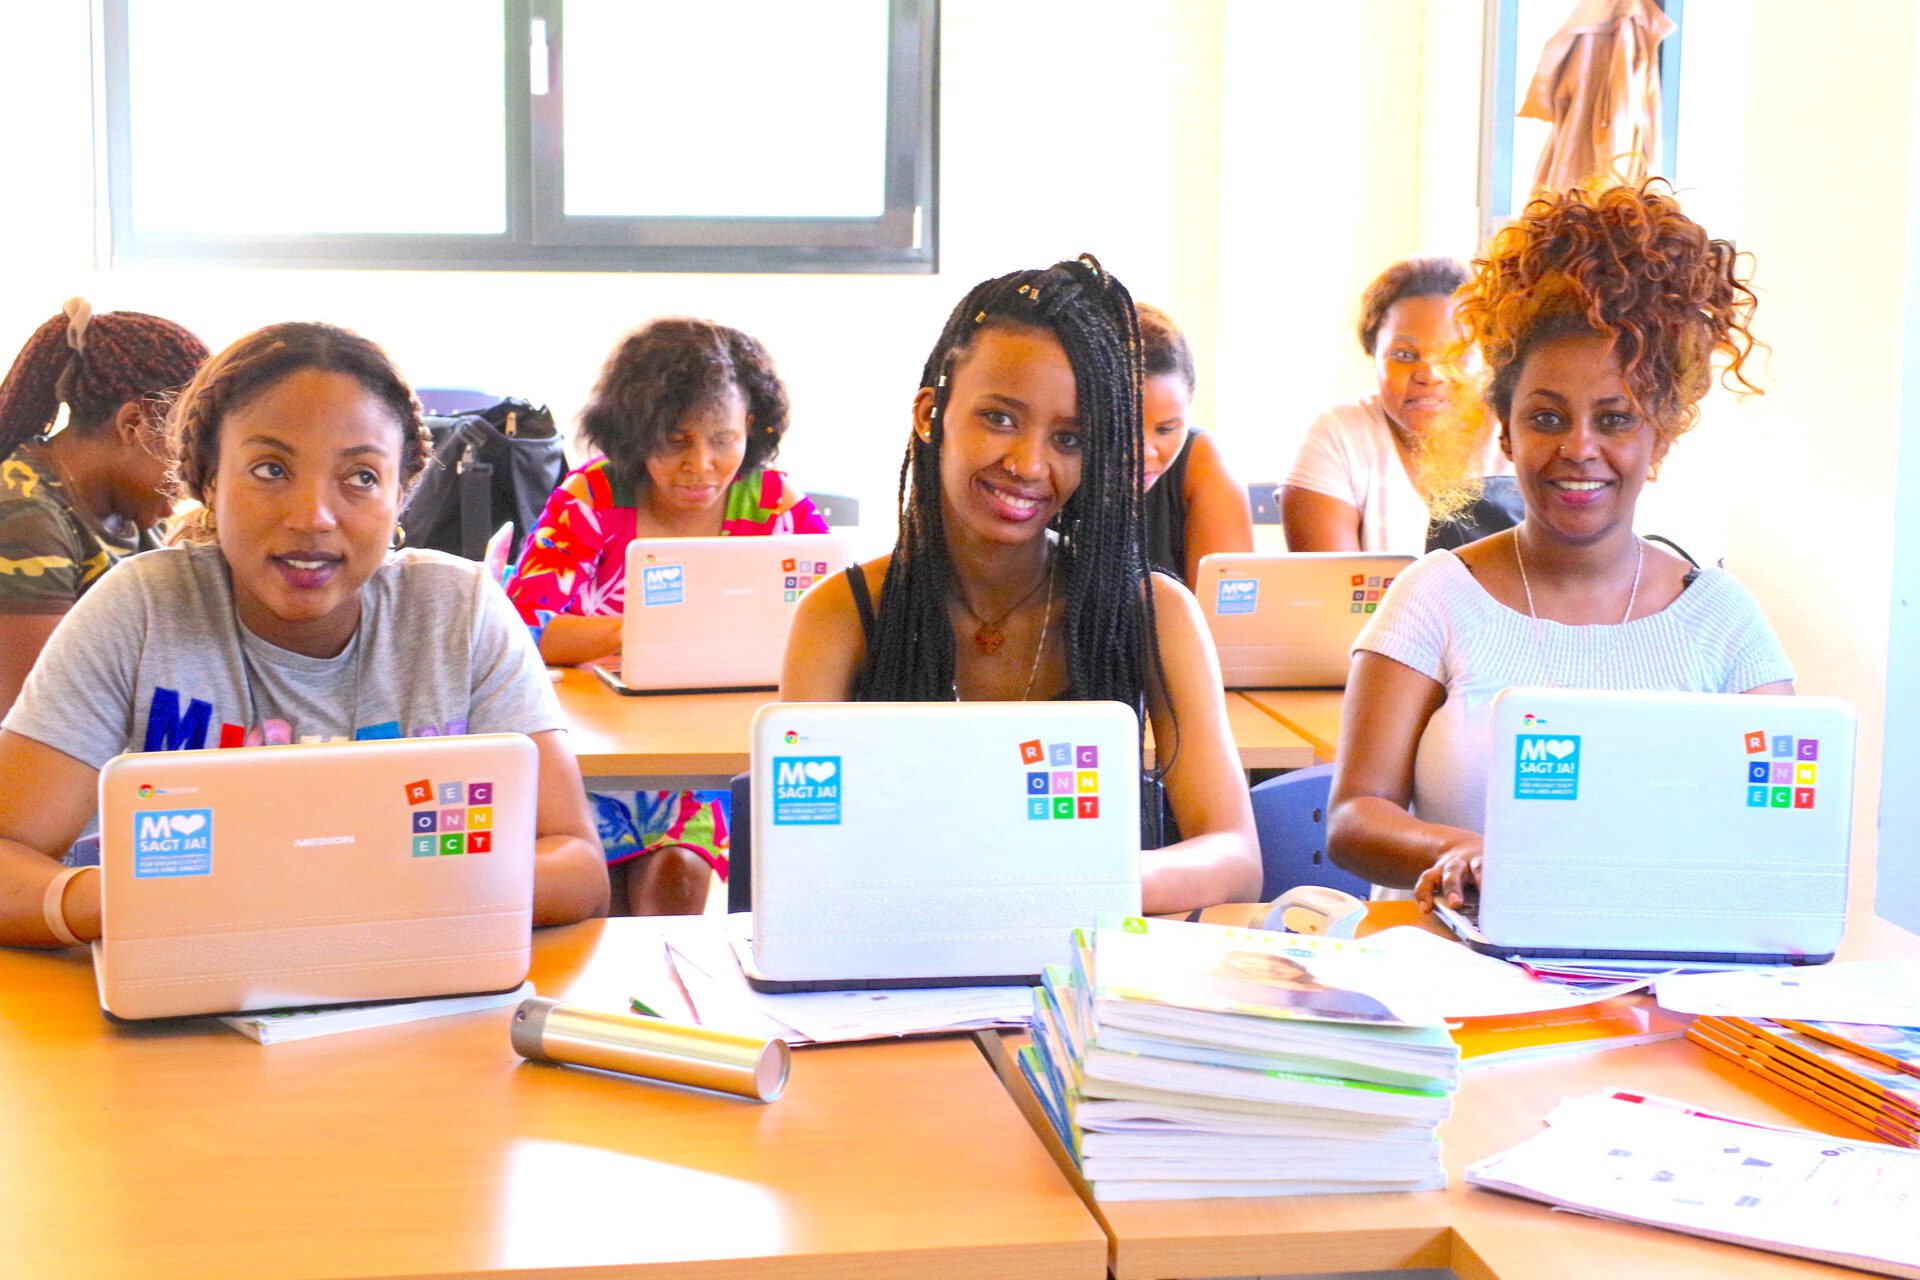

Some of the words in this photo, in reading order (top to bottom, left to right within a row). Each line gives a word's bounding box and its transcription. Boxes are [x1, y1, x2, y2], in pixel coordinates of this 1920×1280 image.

[1520, 762, 1554, 773] SAGT
[1555, 762, 1575, 774] JA!
[778, 785, 814, 799] SAGT
[817, 785, 837, 798] JA!
[140, 838, 180, 852] SAGT
[183, 836, 206, 850] JA!
